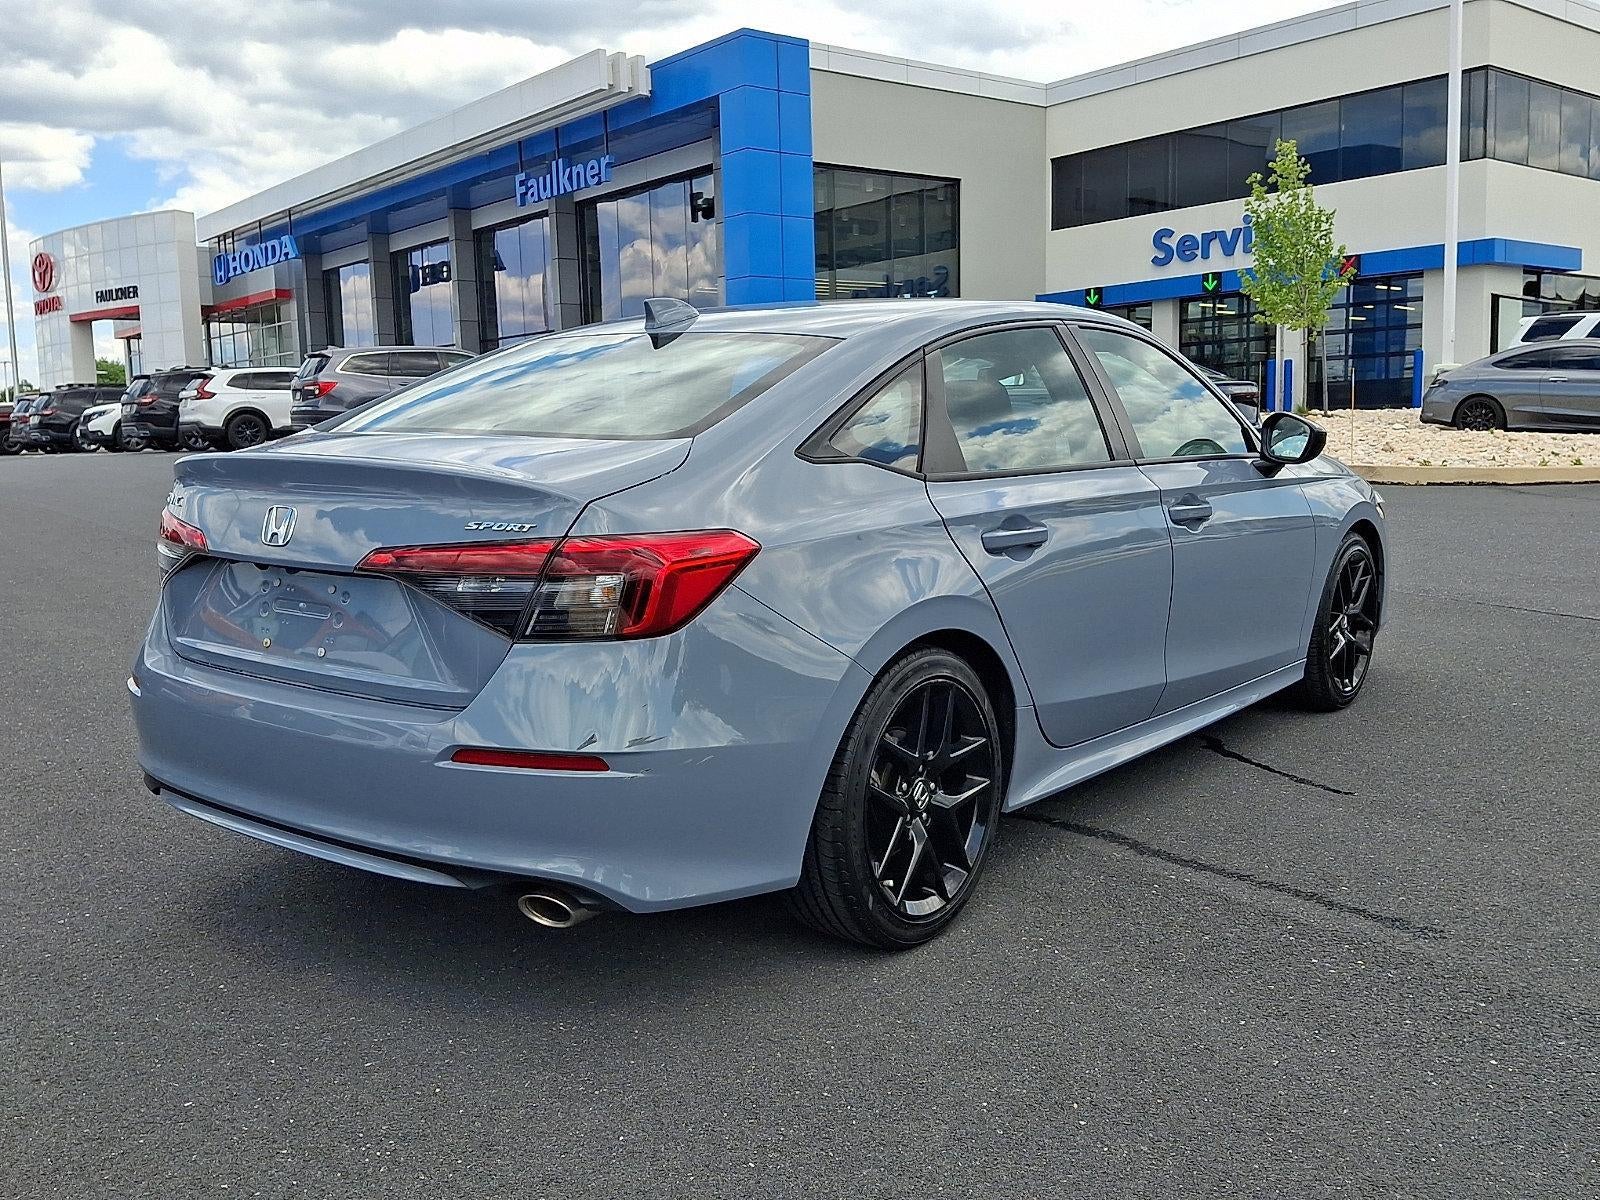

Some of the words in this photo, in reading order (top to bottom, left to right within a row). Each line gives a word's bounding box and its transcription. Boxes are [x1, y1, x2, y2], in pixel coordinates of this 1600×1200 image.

[515, 155, 613, 207] Faulkner
[228, 234, 298, 278] HONDA
[1151, 213, 1256, 267] Servi
[95, 285, 139, 304] FAULKNER
[464, 521, 538, 533] SPORT
